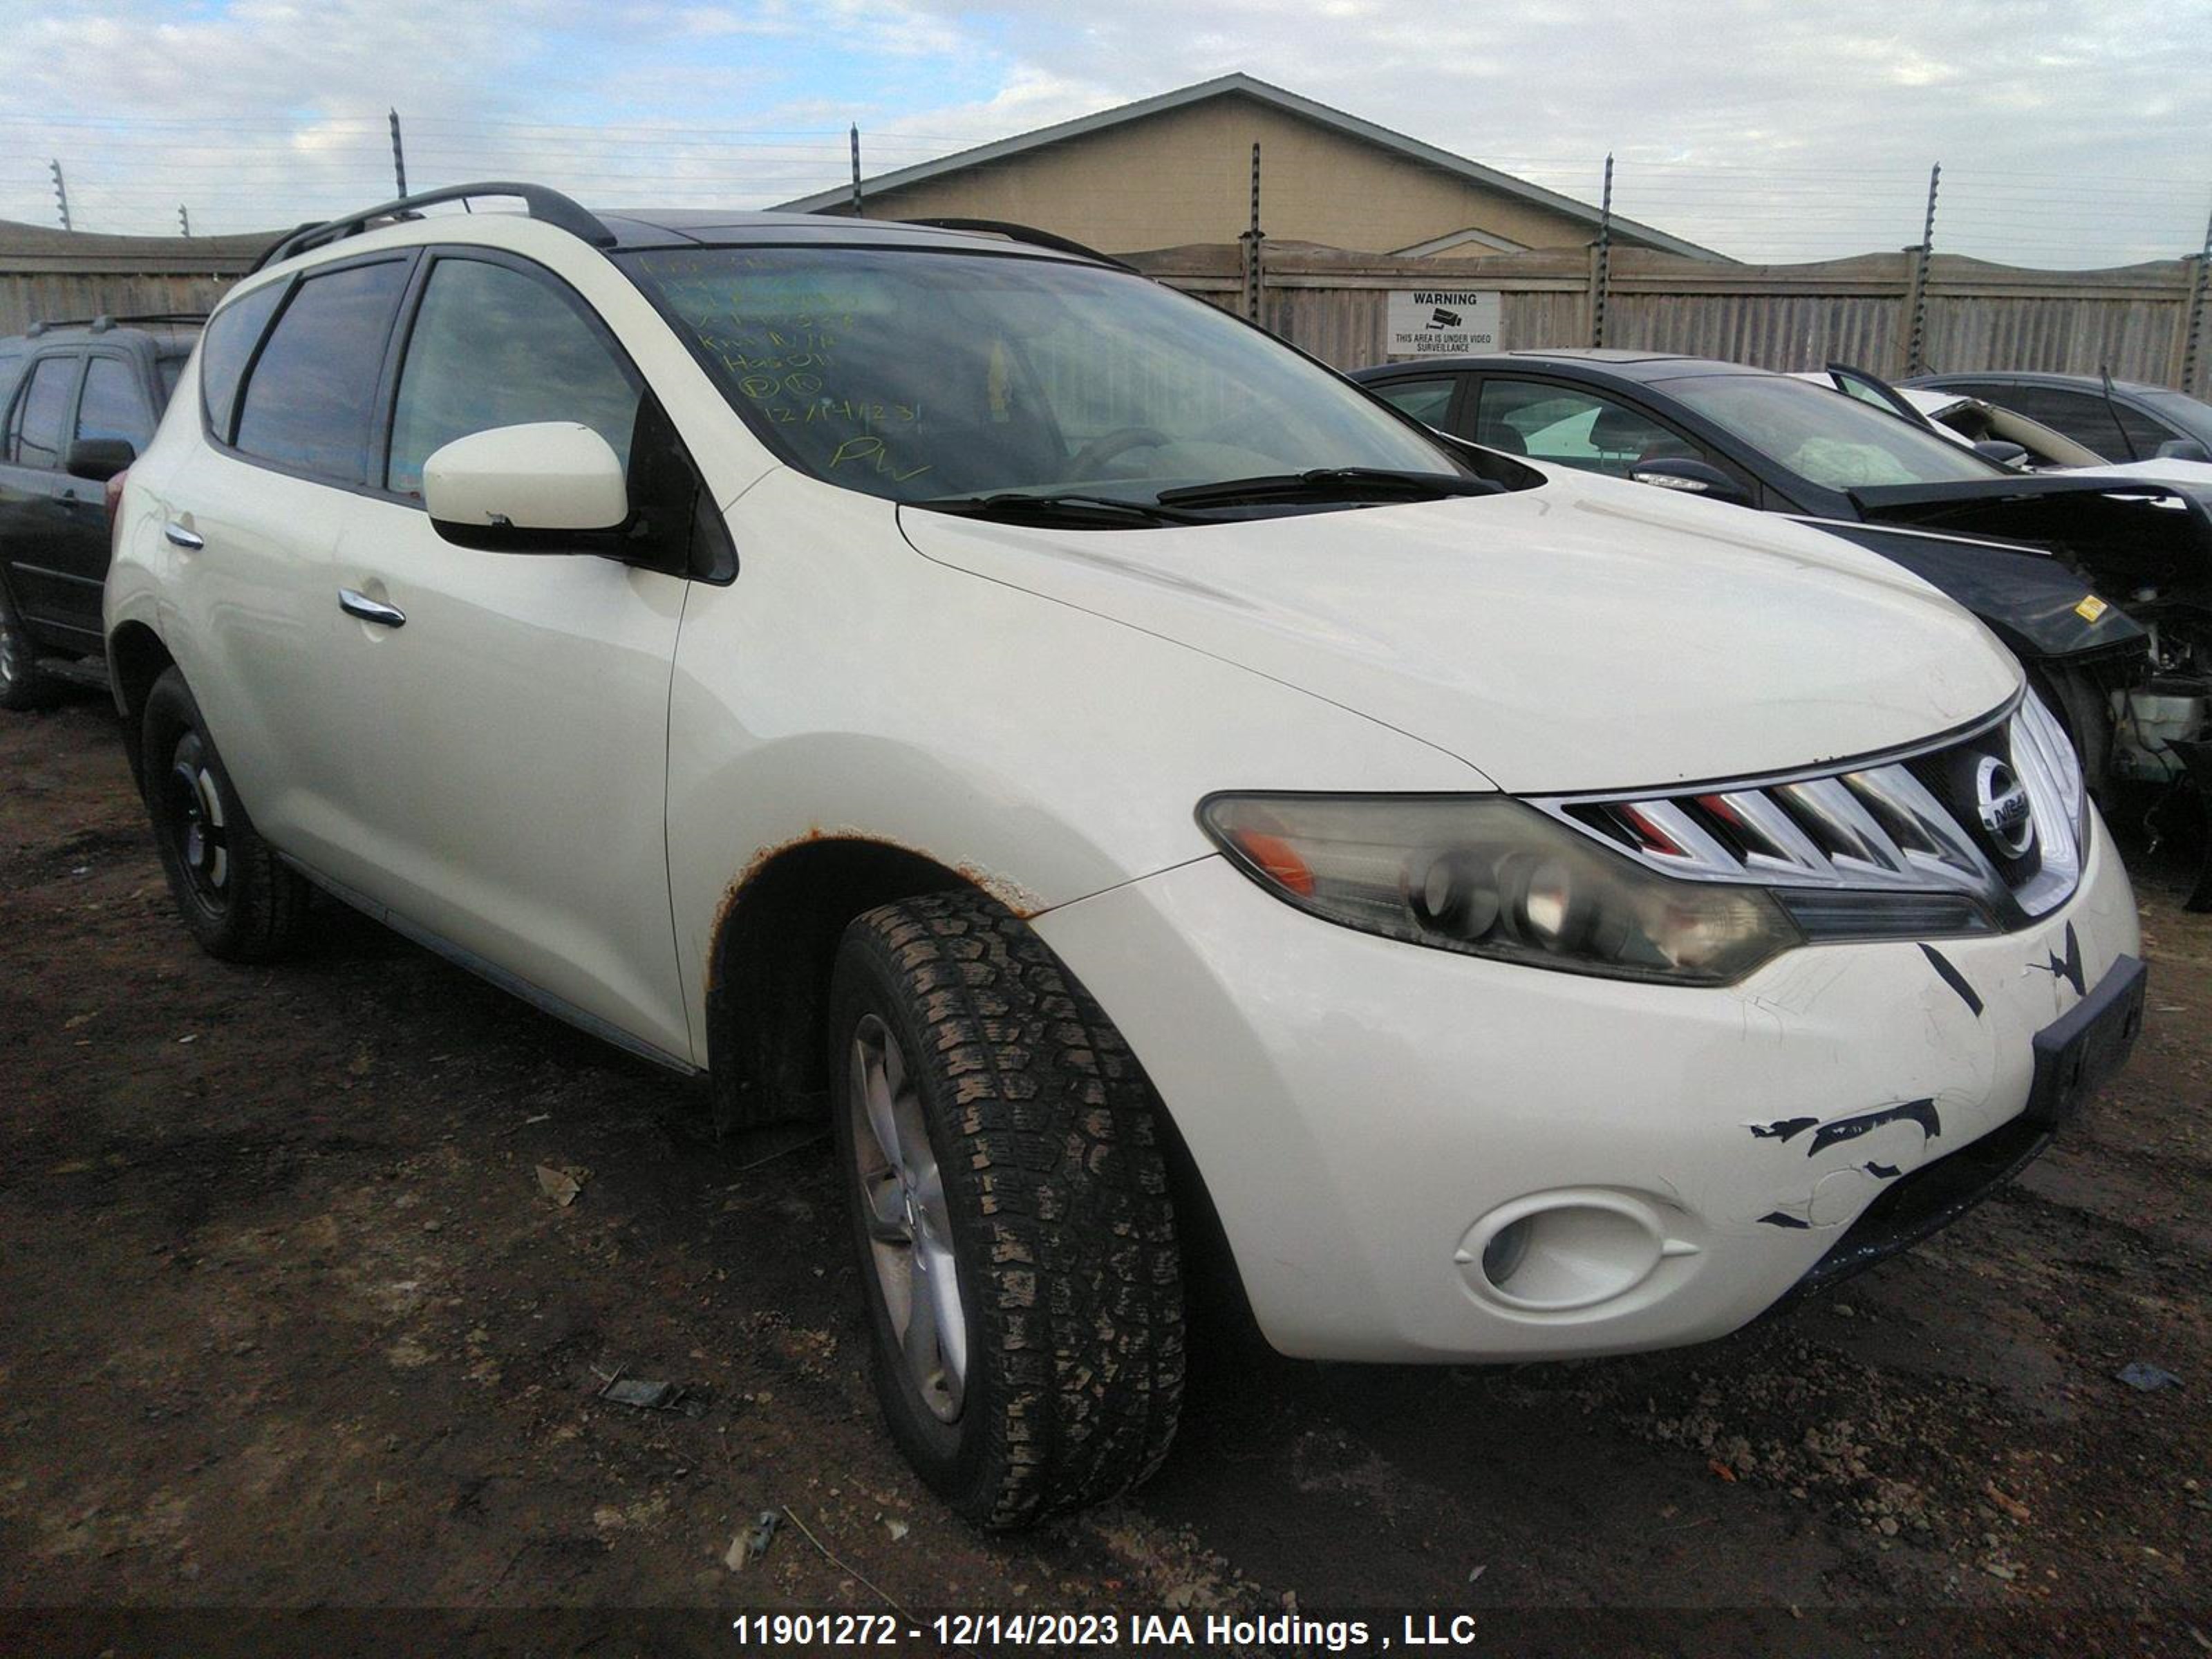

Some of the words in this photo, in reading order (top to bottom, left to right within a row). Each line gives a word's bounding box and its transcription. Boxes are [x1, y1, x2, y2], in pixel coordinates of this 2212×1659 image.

[1414, 293, 1477, 305] WARNING
[1396, 334, 1412, 343] THIS
[1414, 334, 1432, 343] AREA
[1434, 335, 1442, 343] IS
[1444, 335, 1468, 343] UNDER
[1470, 335, 1492, 343] VIDEO
[1417, 344, 1469, 353] SURVEILLANCE
